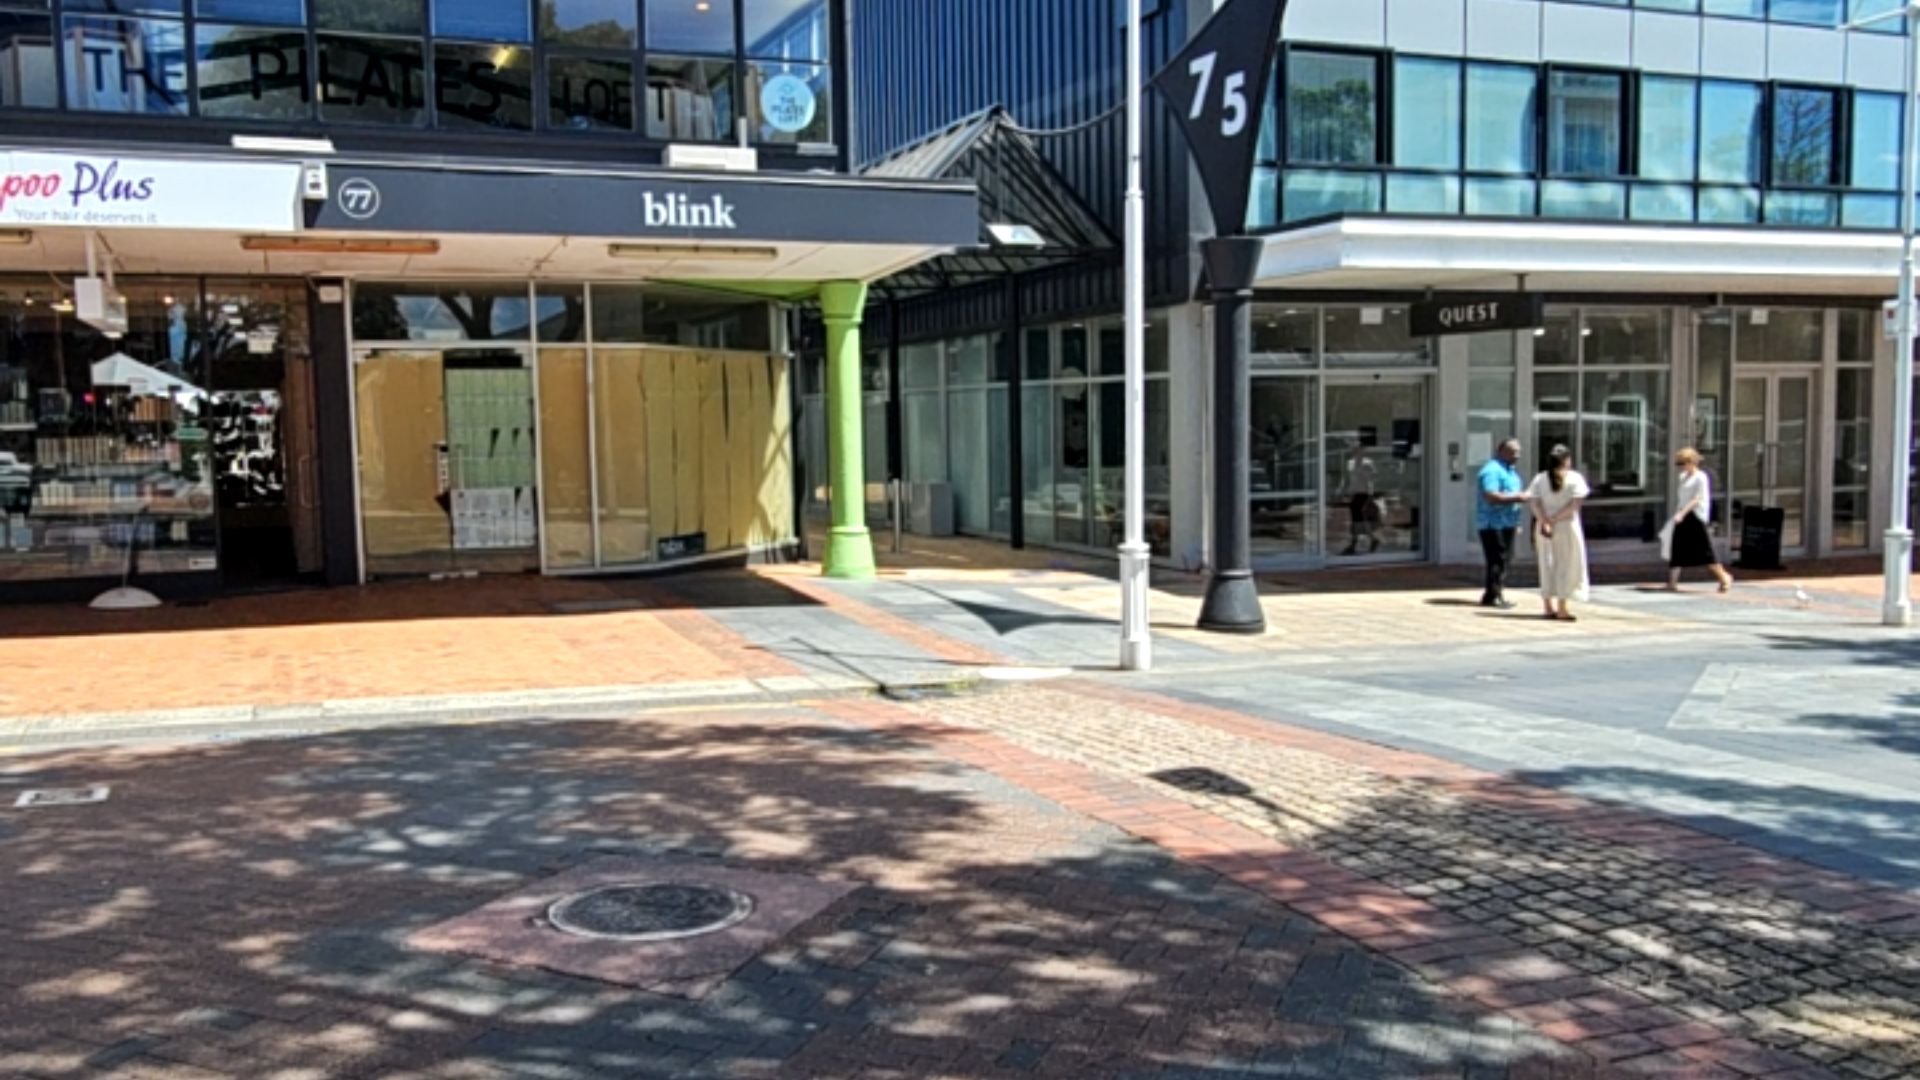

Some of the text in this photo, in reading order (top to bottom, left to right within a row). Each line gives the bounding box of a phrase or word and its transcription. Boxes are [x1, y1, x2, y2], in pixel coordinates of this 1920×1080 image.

[82, 46, 673, 122] THE PILATES LOFT
[1189, 51, 1248, 136] 75
[69, 159, 155, 207] Plus
[345, 188, 372, 210] 77
[14, 208, 158, 223] Your hair deserves it
[642, 191, 736, 228] blink
[1439, 302, 1499, 327] QUEST
